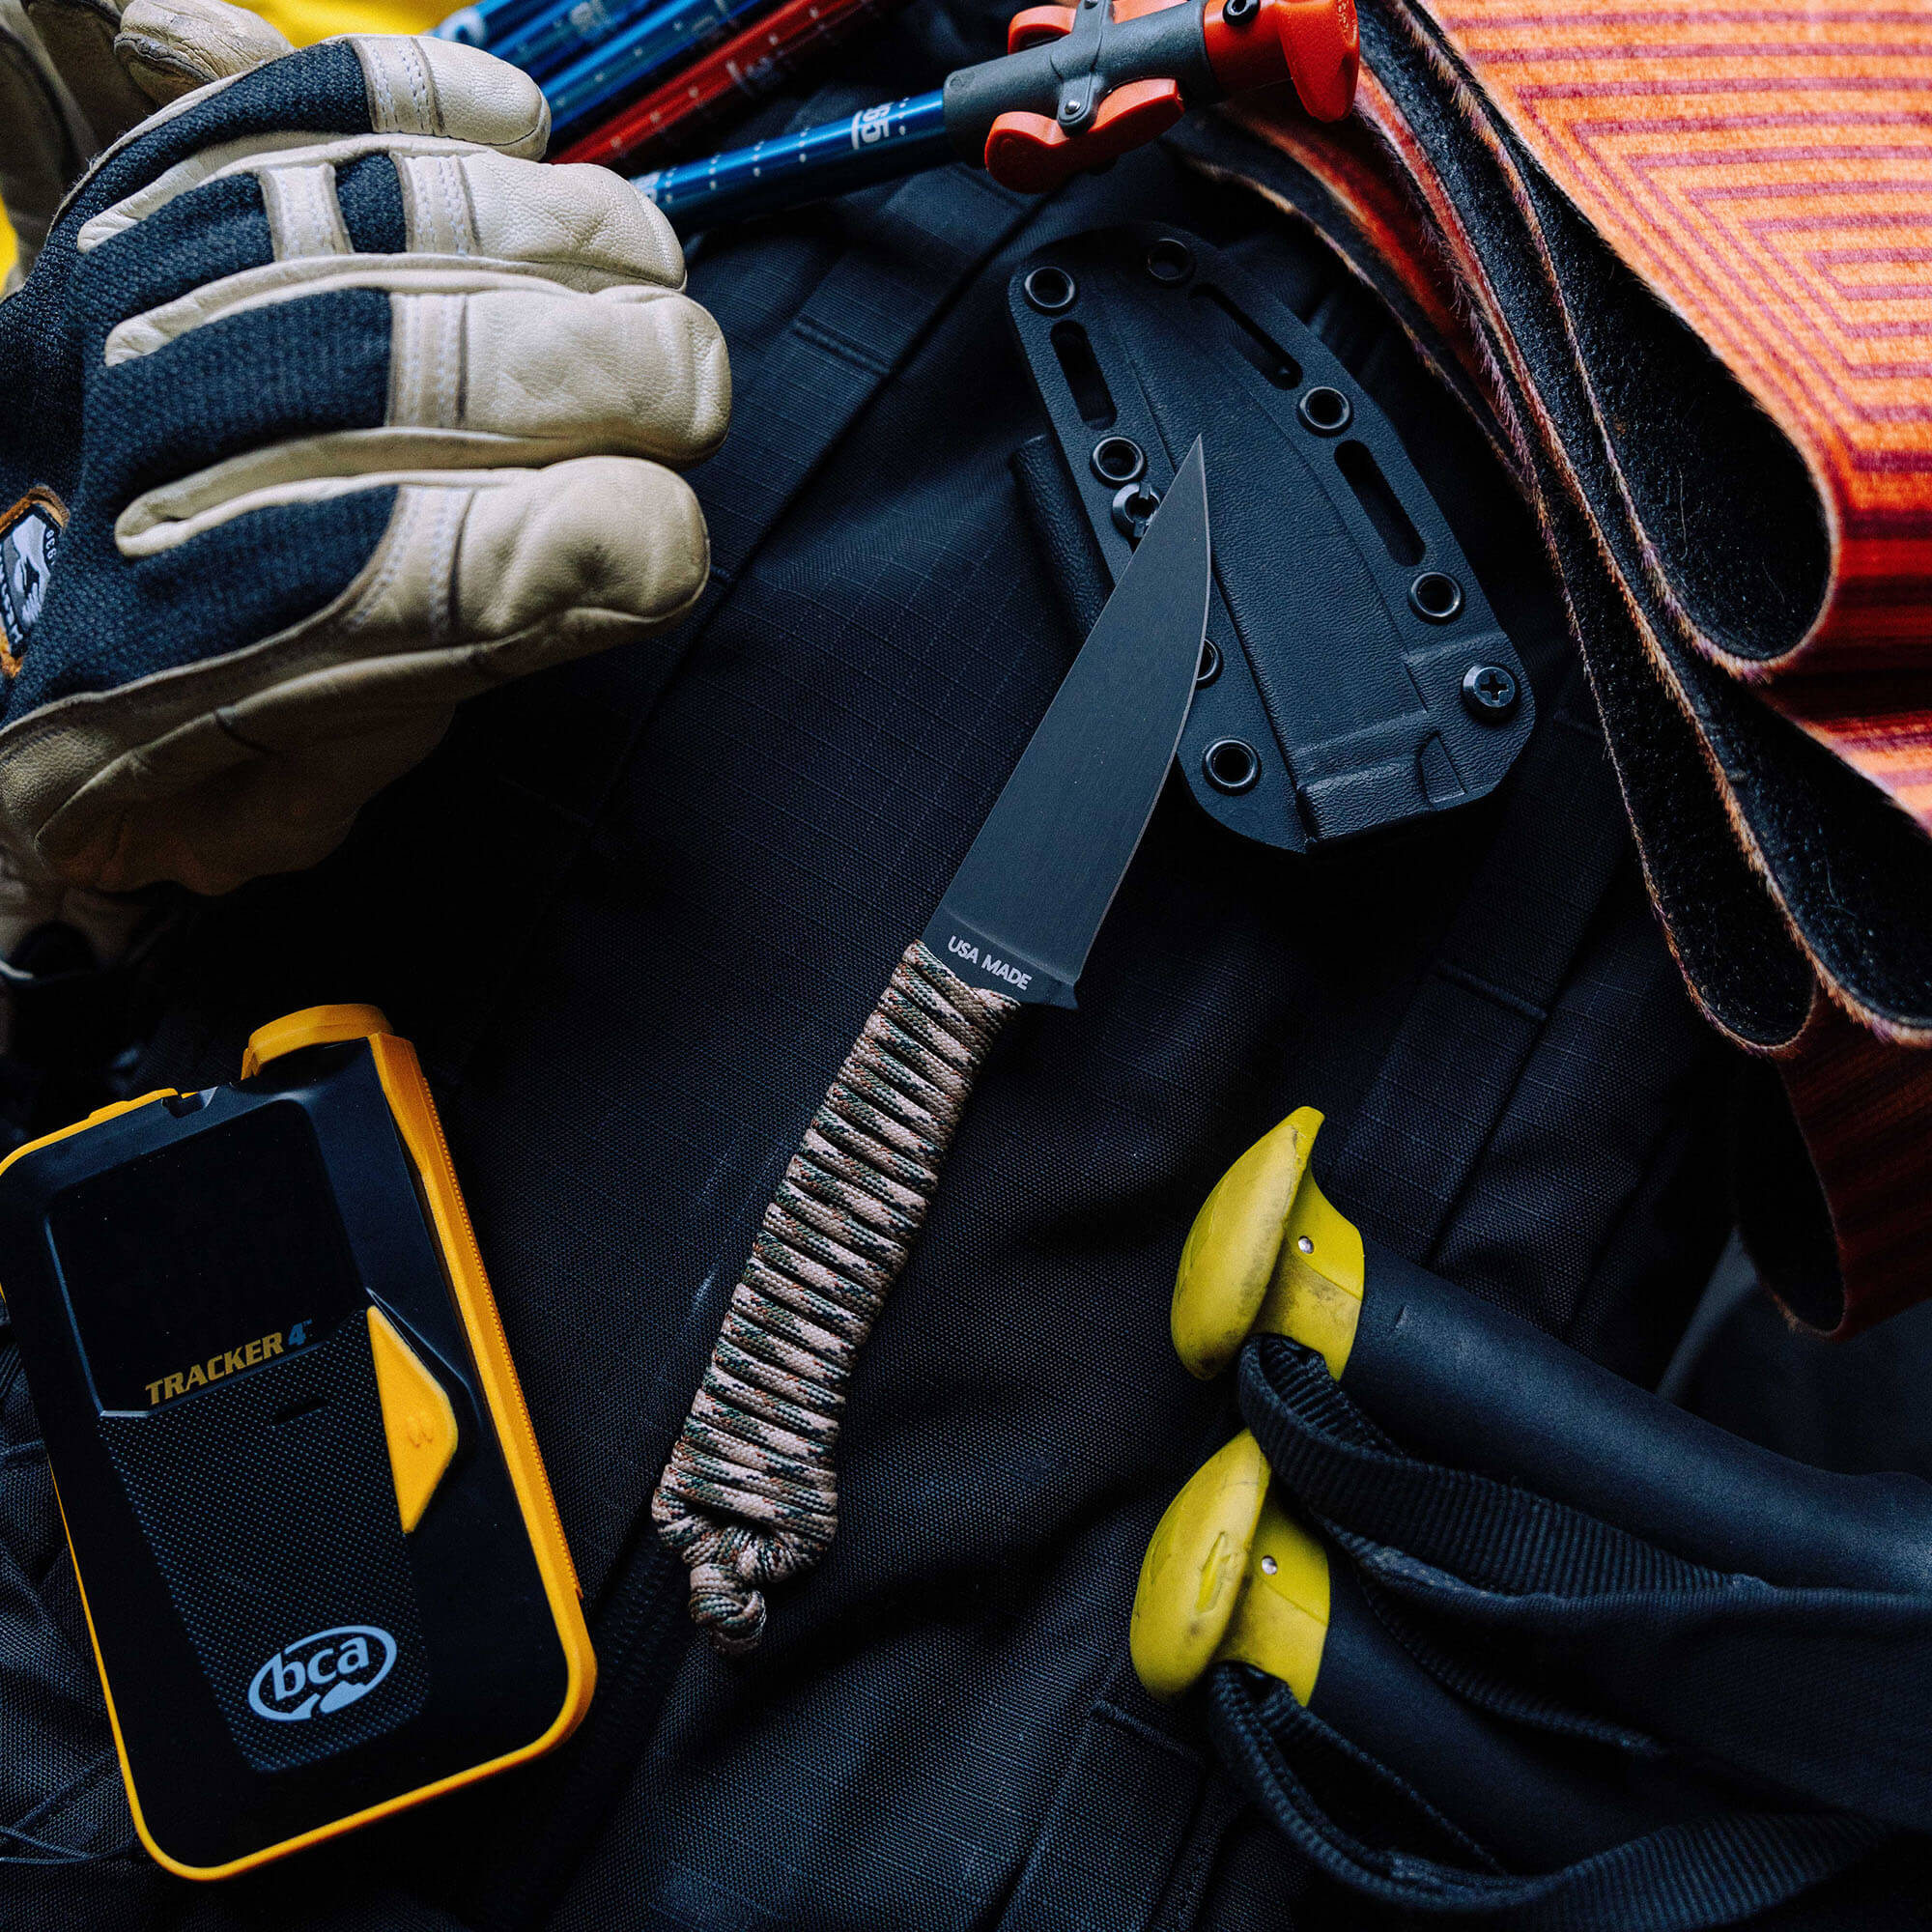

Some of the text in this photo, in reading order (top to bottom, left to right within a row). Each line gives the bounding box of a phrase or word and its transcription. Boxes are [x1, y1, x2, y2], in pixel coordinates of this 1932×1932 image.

[948, 935, 1033, 990] USA MADE
[145, 1332, 284, 1406] TRACKER
[271, 1636, 369, 1702] bca
